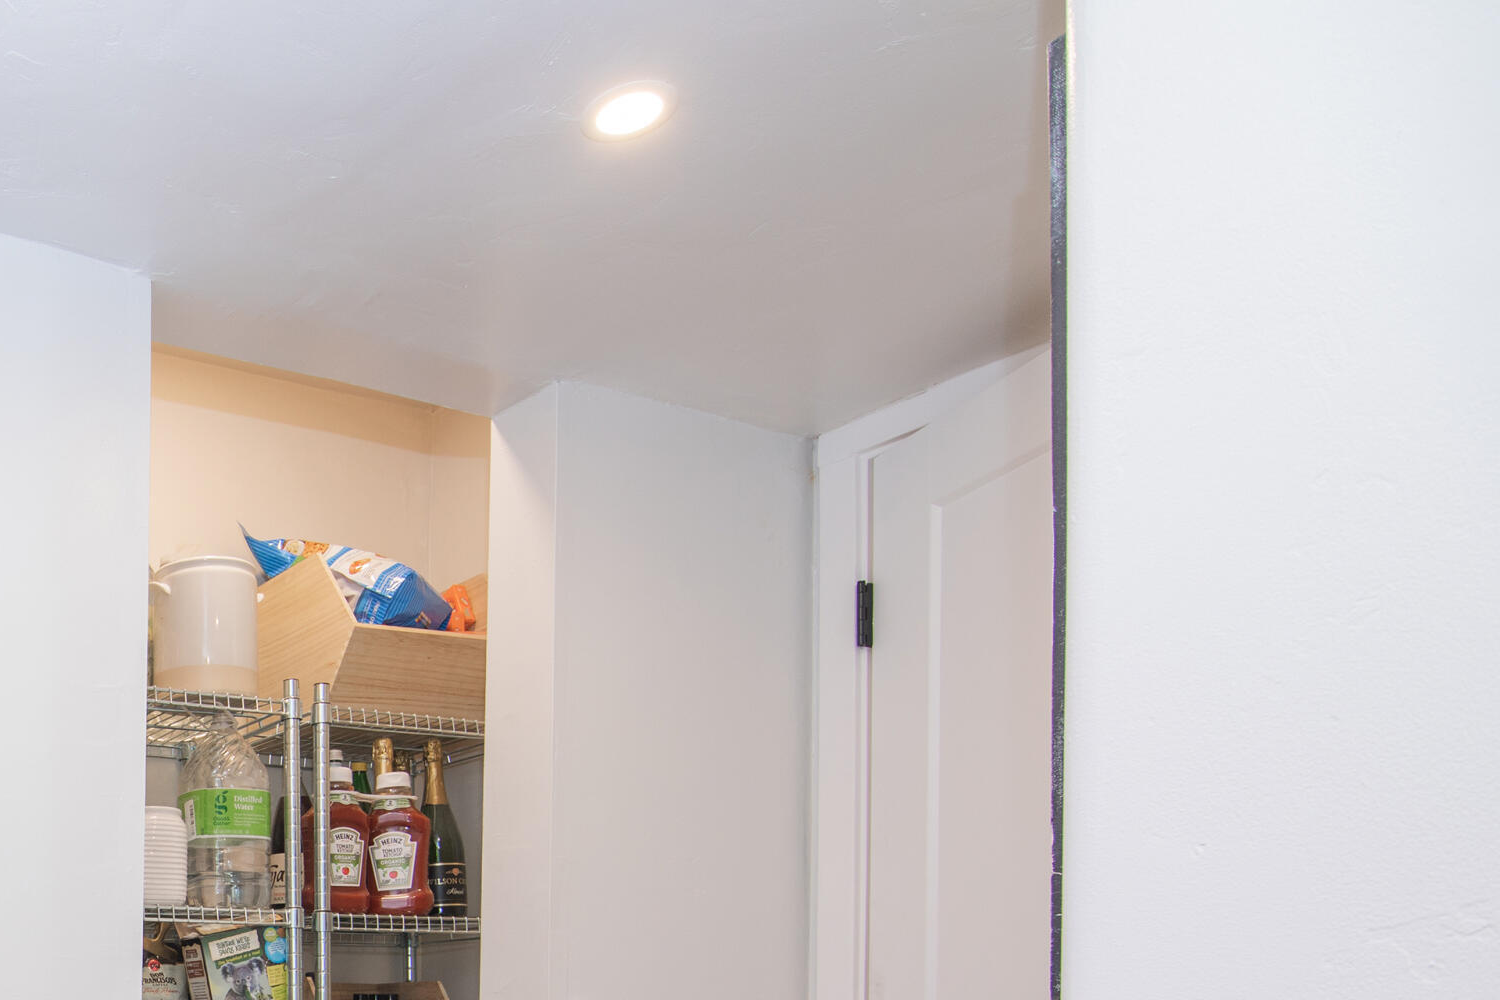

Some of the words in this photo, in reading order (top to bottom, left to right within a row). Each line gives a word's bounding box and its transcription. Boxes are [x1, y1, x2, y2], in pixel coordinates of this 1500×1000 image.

[234, 795, 263, 803] Distilled
[234, 803, 254, 811] Water
[335, 832, 354, 840] HEINZ
[381, 838, 403, 846] HEINZ
